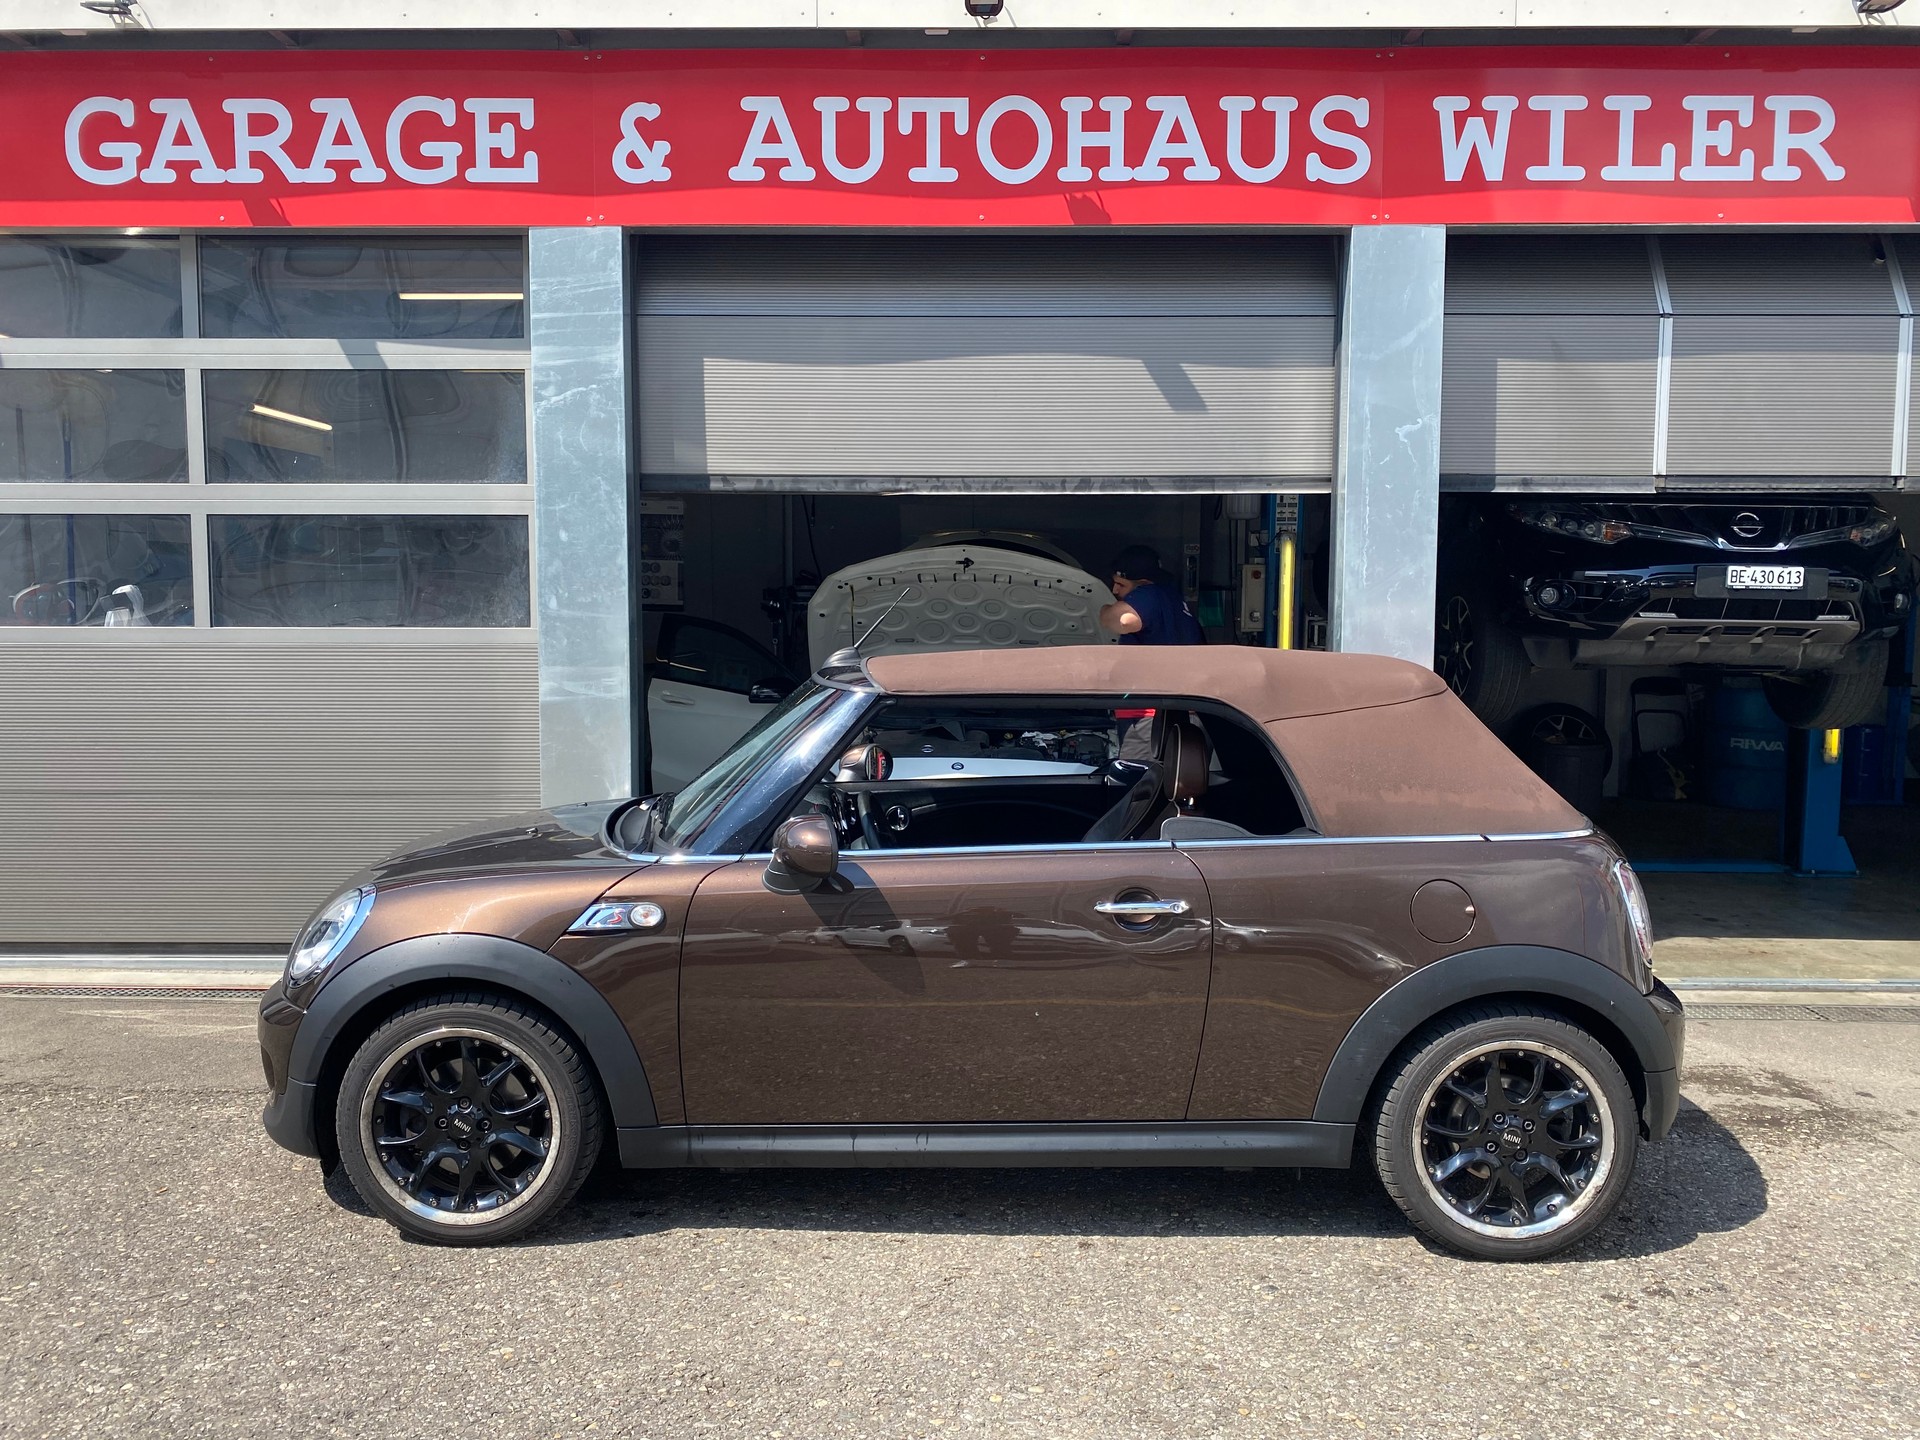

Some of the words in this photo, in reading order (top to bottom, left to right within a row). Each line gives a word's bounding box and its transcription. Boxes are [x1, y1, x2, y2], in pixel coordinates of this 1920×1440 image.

[64, 96, 540, 186] GARAGE
[612, 102, 671, 184] &
[728, 95, 1371, 185] AUTOHAUS
[1432, 95, 1846, 182] WILER
[1730, 737, 1785, 752] RIWA
[453, 1118, 472, 1133] MINI
[1503, 1132, 1521, 1144] MINI
